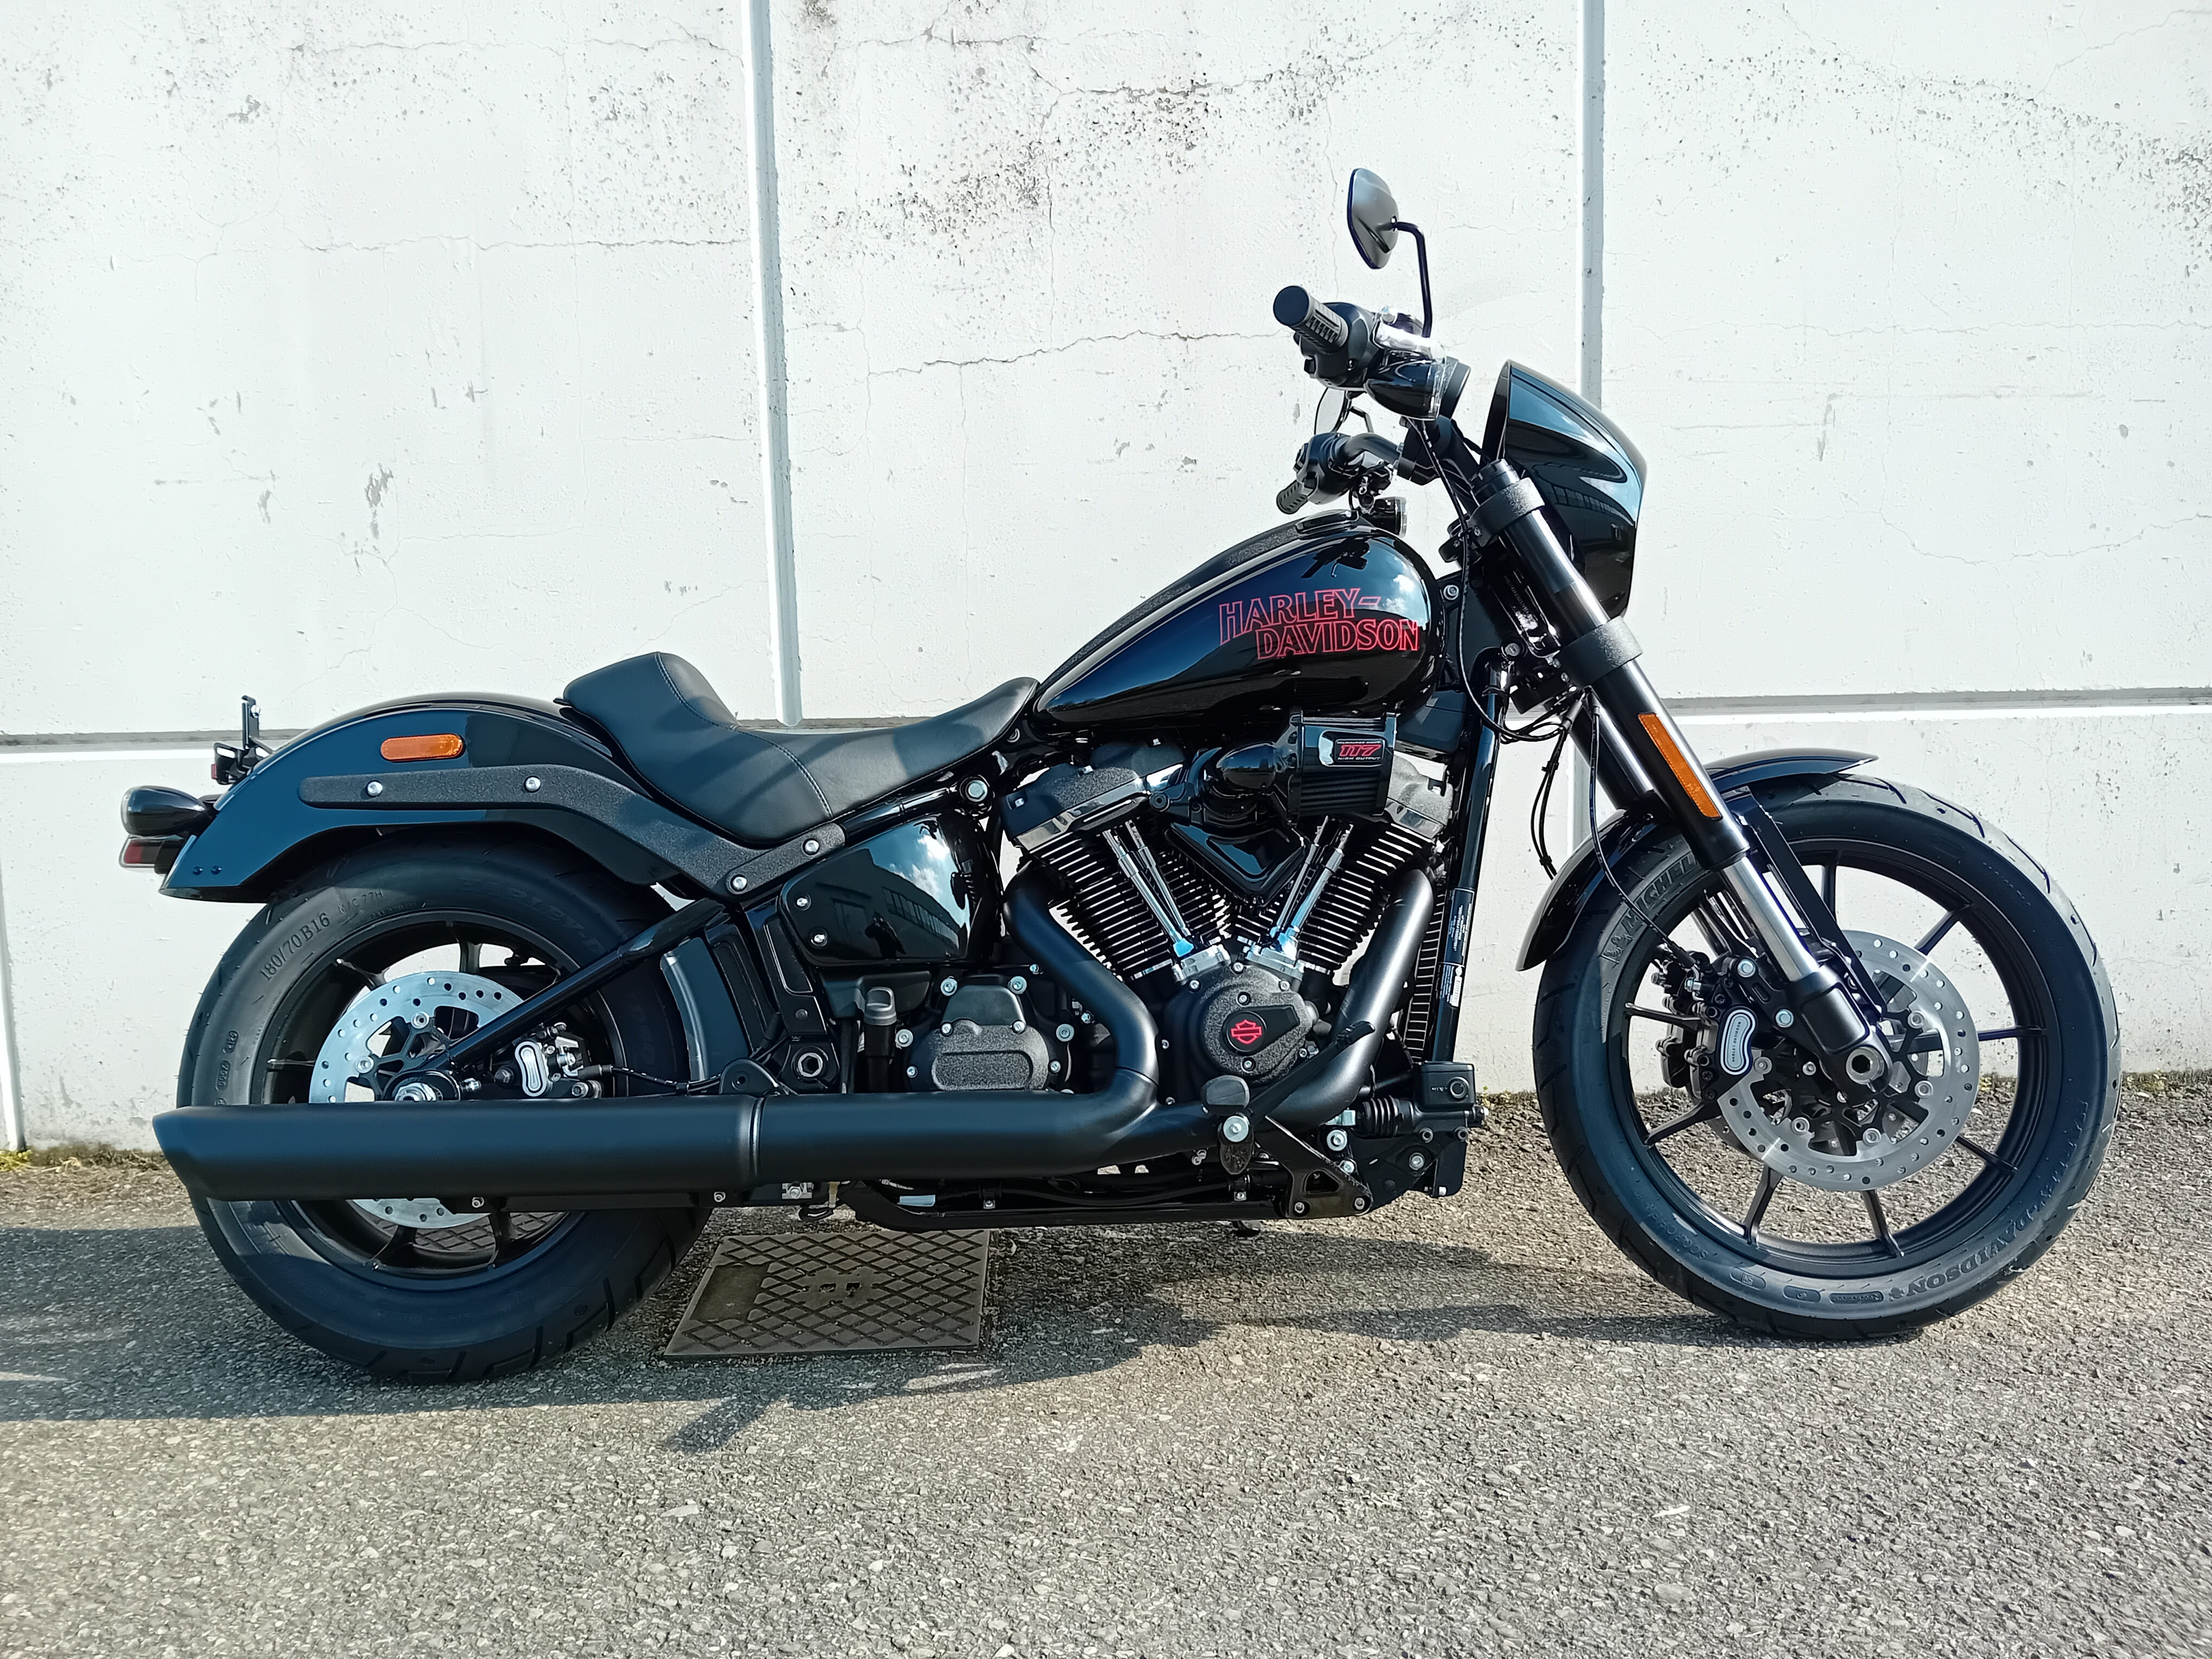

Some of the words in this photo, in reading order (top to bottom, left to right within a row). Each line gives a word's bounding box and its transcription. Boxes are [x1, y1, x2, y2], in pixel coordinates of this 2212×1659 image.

[1219, 588, 1381, 646] HARLEY-
[1255, 619, 1418, 660] DAVIDSON
[1339, 744, 1382, 757] 117
[1621, 853, 1698, 934] MICHEL
